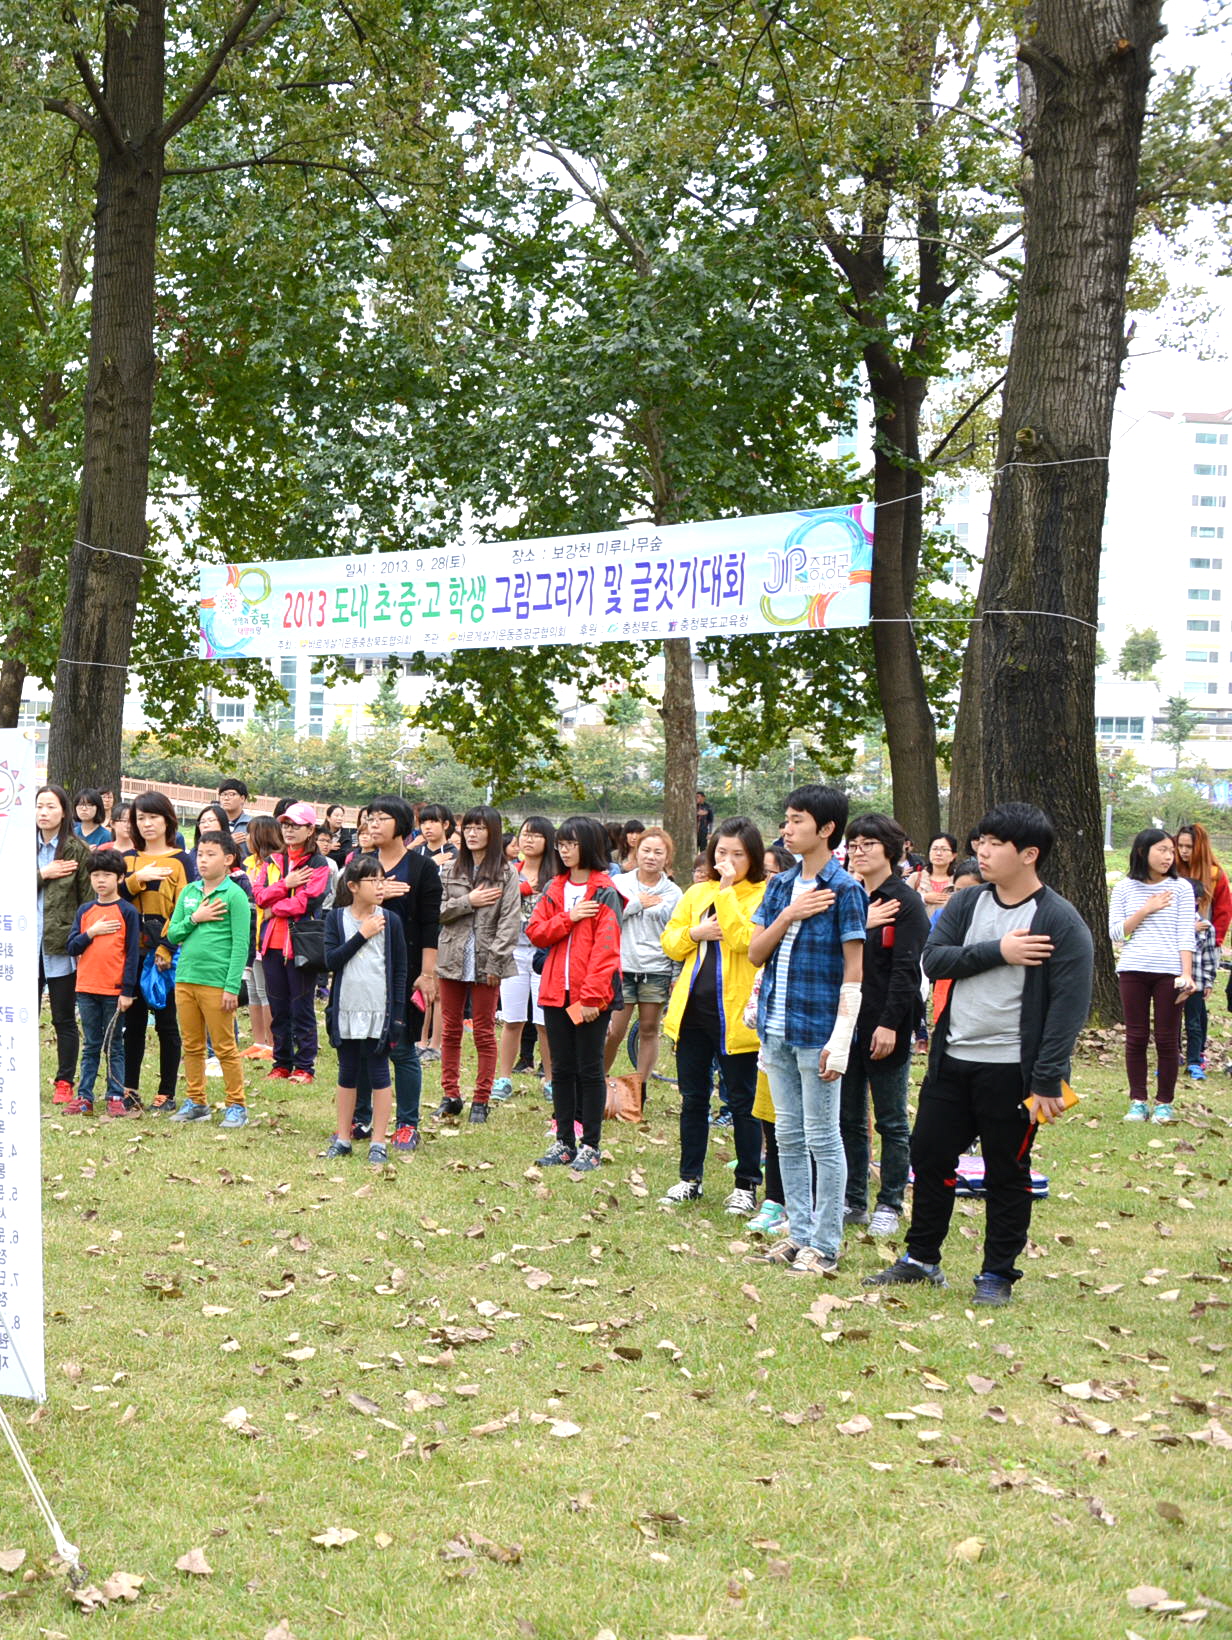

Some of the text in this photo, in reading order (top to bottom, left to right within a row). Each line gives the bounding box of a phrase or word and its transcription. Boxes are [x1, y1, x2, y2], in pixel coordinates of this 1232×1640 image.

[512, 536, 664, 565] 장소 보강천 미루나무숲
[345, 556, 466, 577] 일시 2013. 9. 28(토)
[809, 554, 848, 580] 증평군
[283, 590, 327, 629] 2013
[332, 583, 368, 629] 도내
[449, 575, 487, 624] 학생
[491, 566, 595, 620] 그림그리기
[605, 564, 623, 615] 및
[631, 552, 746, 613] 글짓기대회
[250, 608, 270, 628] 충북
[579, 623, 597, 636] 후원
[680, 614, 749, 631] 충청북도교육청
